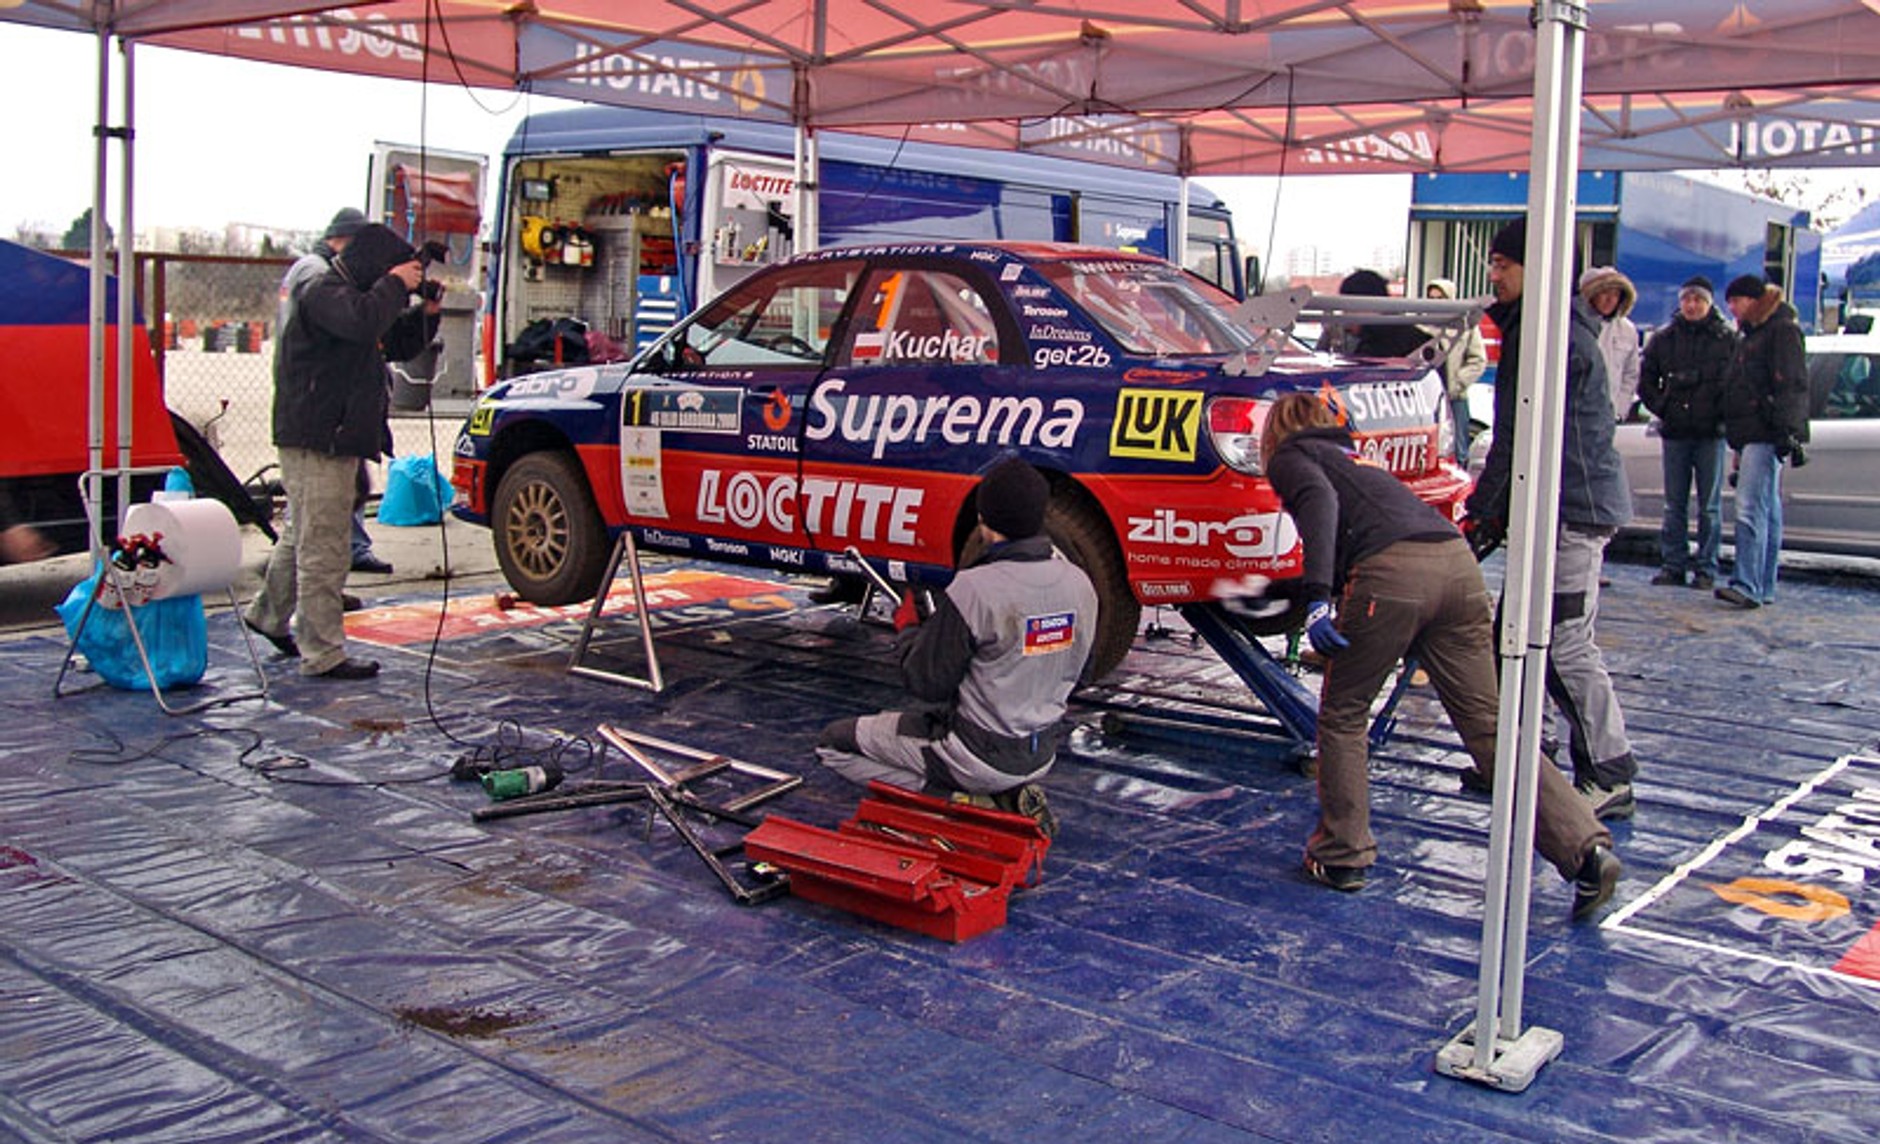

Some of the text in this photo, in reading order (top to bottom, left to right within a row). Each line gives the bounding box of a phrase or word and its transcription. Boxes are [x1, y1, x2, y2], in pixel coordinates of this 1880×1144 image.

[730, 172, 794, 194] LOCTITE
[875, 271, 903, 329] 1
[886, 328, 991, 359] Kuchar
[632, 389, 644, 425] 1
[805, 378, 1084, 459] Suprema
[1349, 381, 1431, 421] STATOIL
[747, 434, 799, 452] STATOIL
[1354, 434, 1428, 475] LOCTITE
[696, 469, 925, 546] LOCTITE
[1127, 509, 1298, 558] zibro
